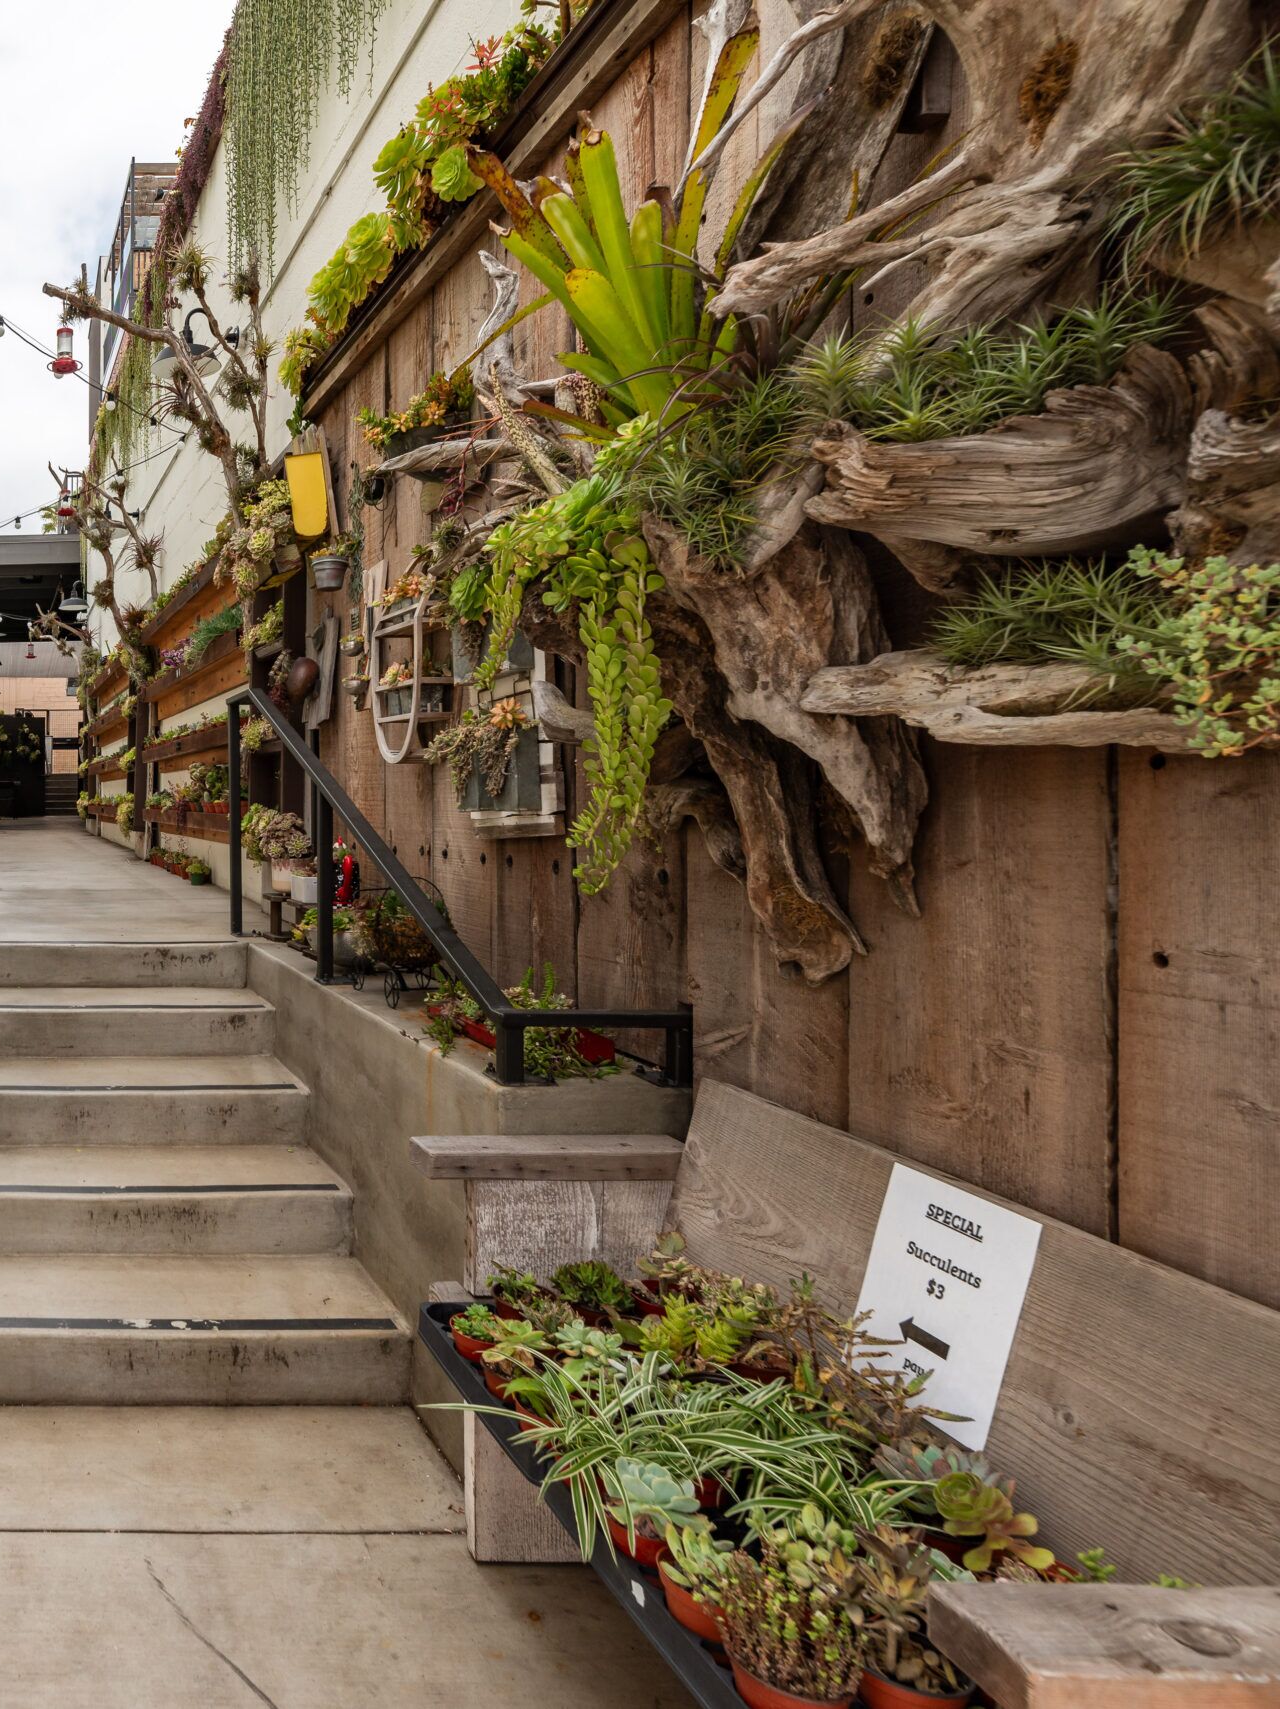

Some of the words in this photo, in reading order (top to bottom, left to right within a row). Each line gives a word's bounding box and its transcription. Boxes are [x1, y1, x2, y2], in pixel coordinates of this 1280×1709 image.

[925, 1203, 984, 1242] SPECIAL
[906, 1241, 982, 1289] Succulents
[926, 1278, 945, 1300] $3
